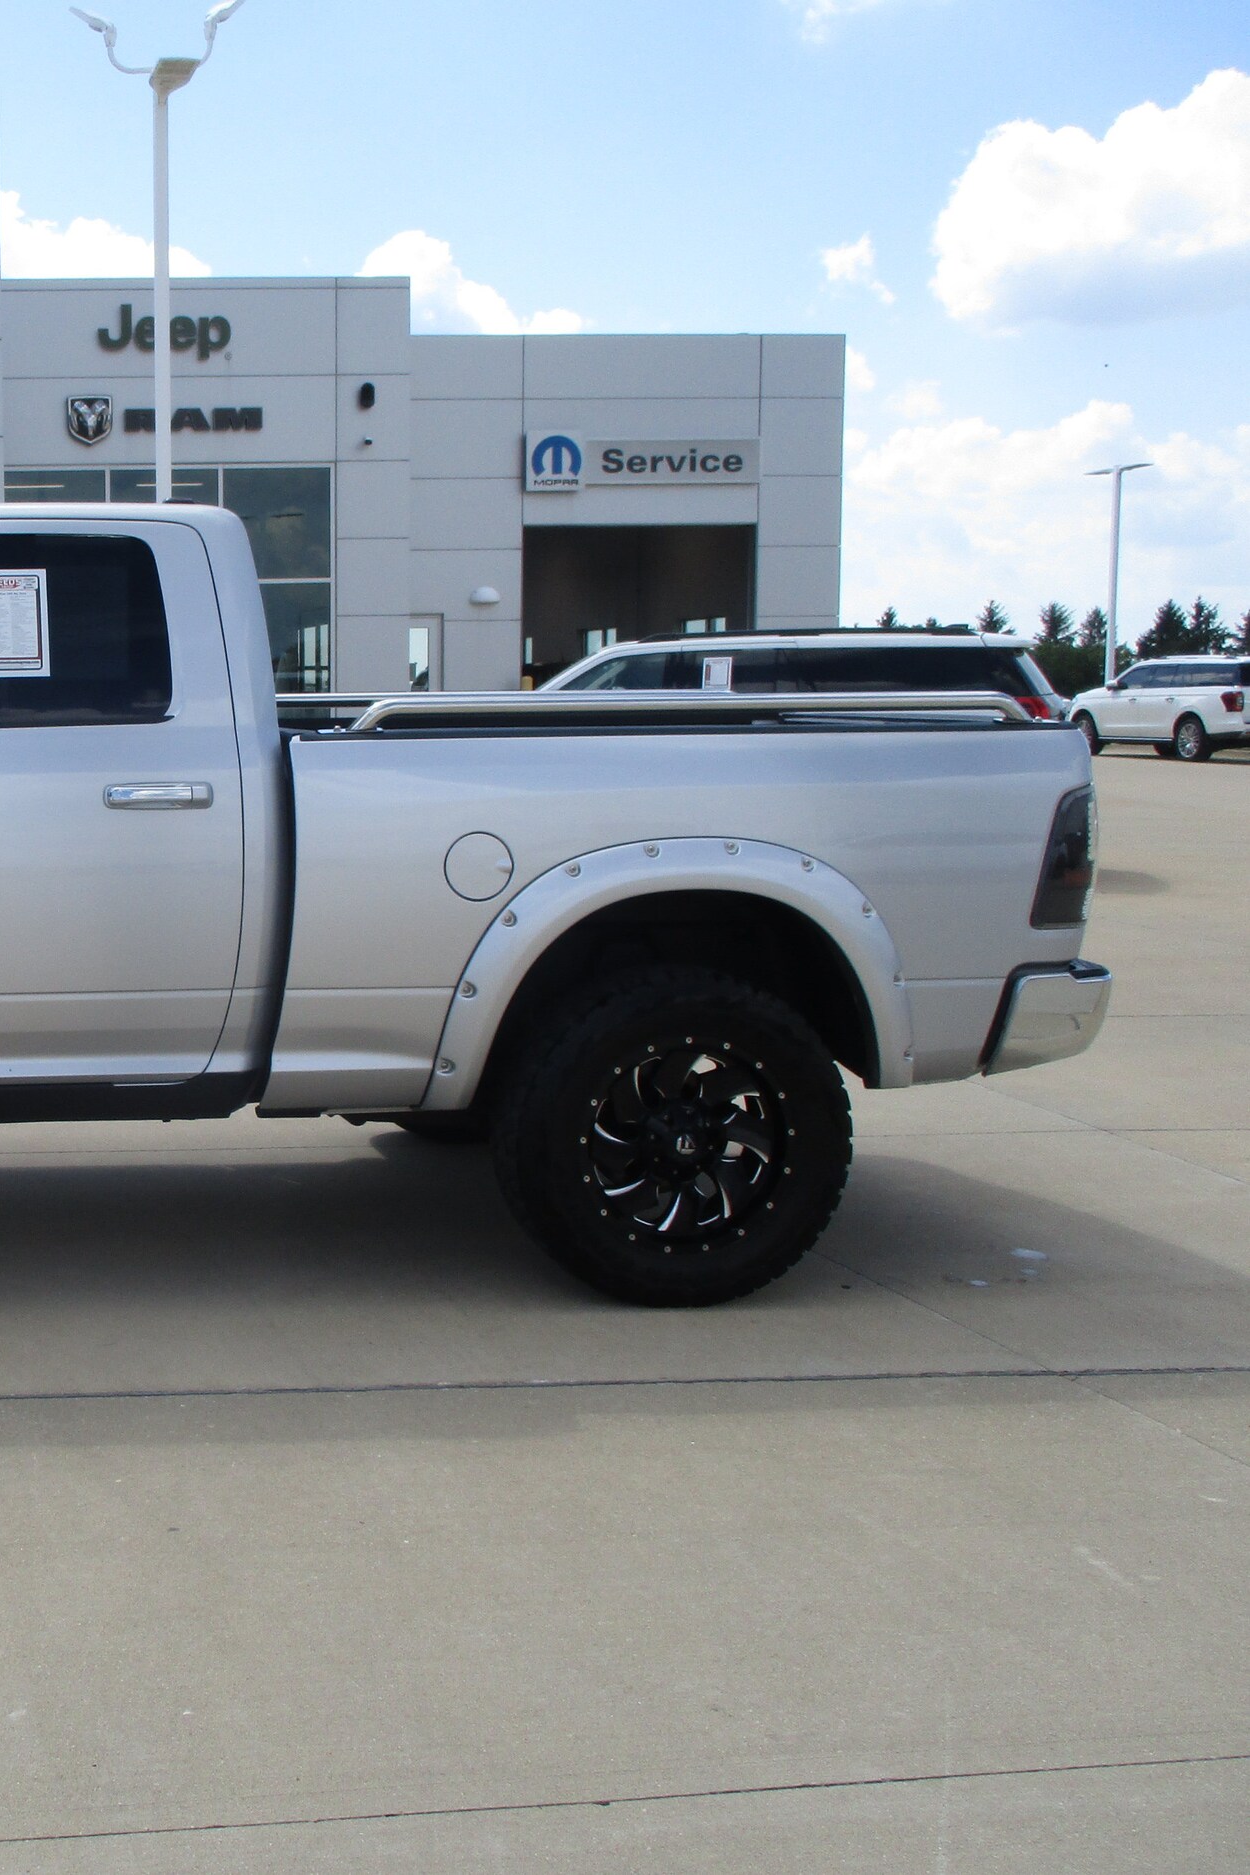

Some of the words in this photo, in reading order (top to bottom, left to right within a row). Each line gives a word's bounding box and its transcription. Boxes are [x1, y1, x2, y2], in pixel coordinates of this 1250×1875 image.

[97, 303, 232, 362] Jeep
[124, 406, 263, 432] RAM
[601, 448, 743, 474] Service
[533, 478, 579, 487] MOPAR
